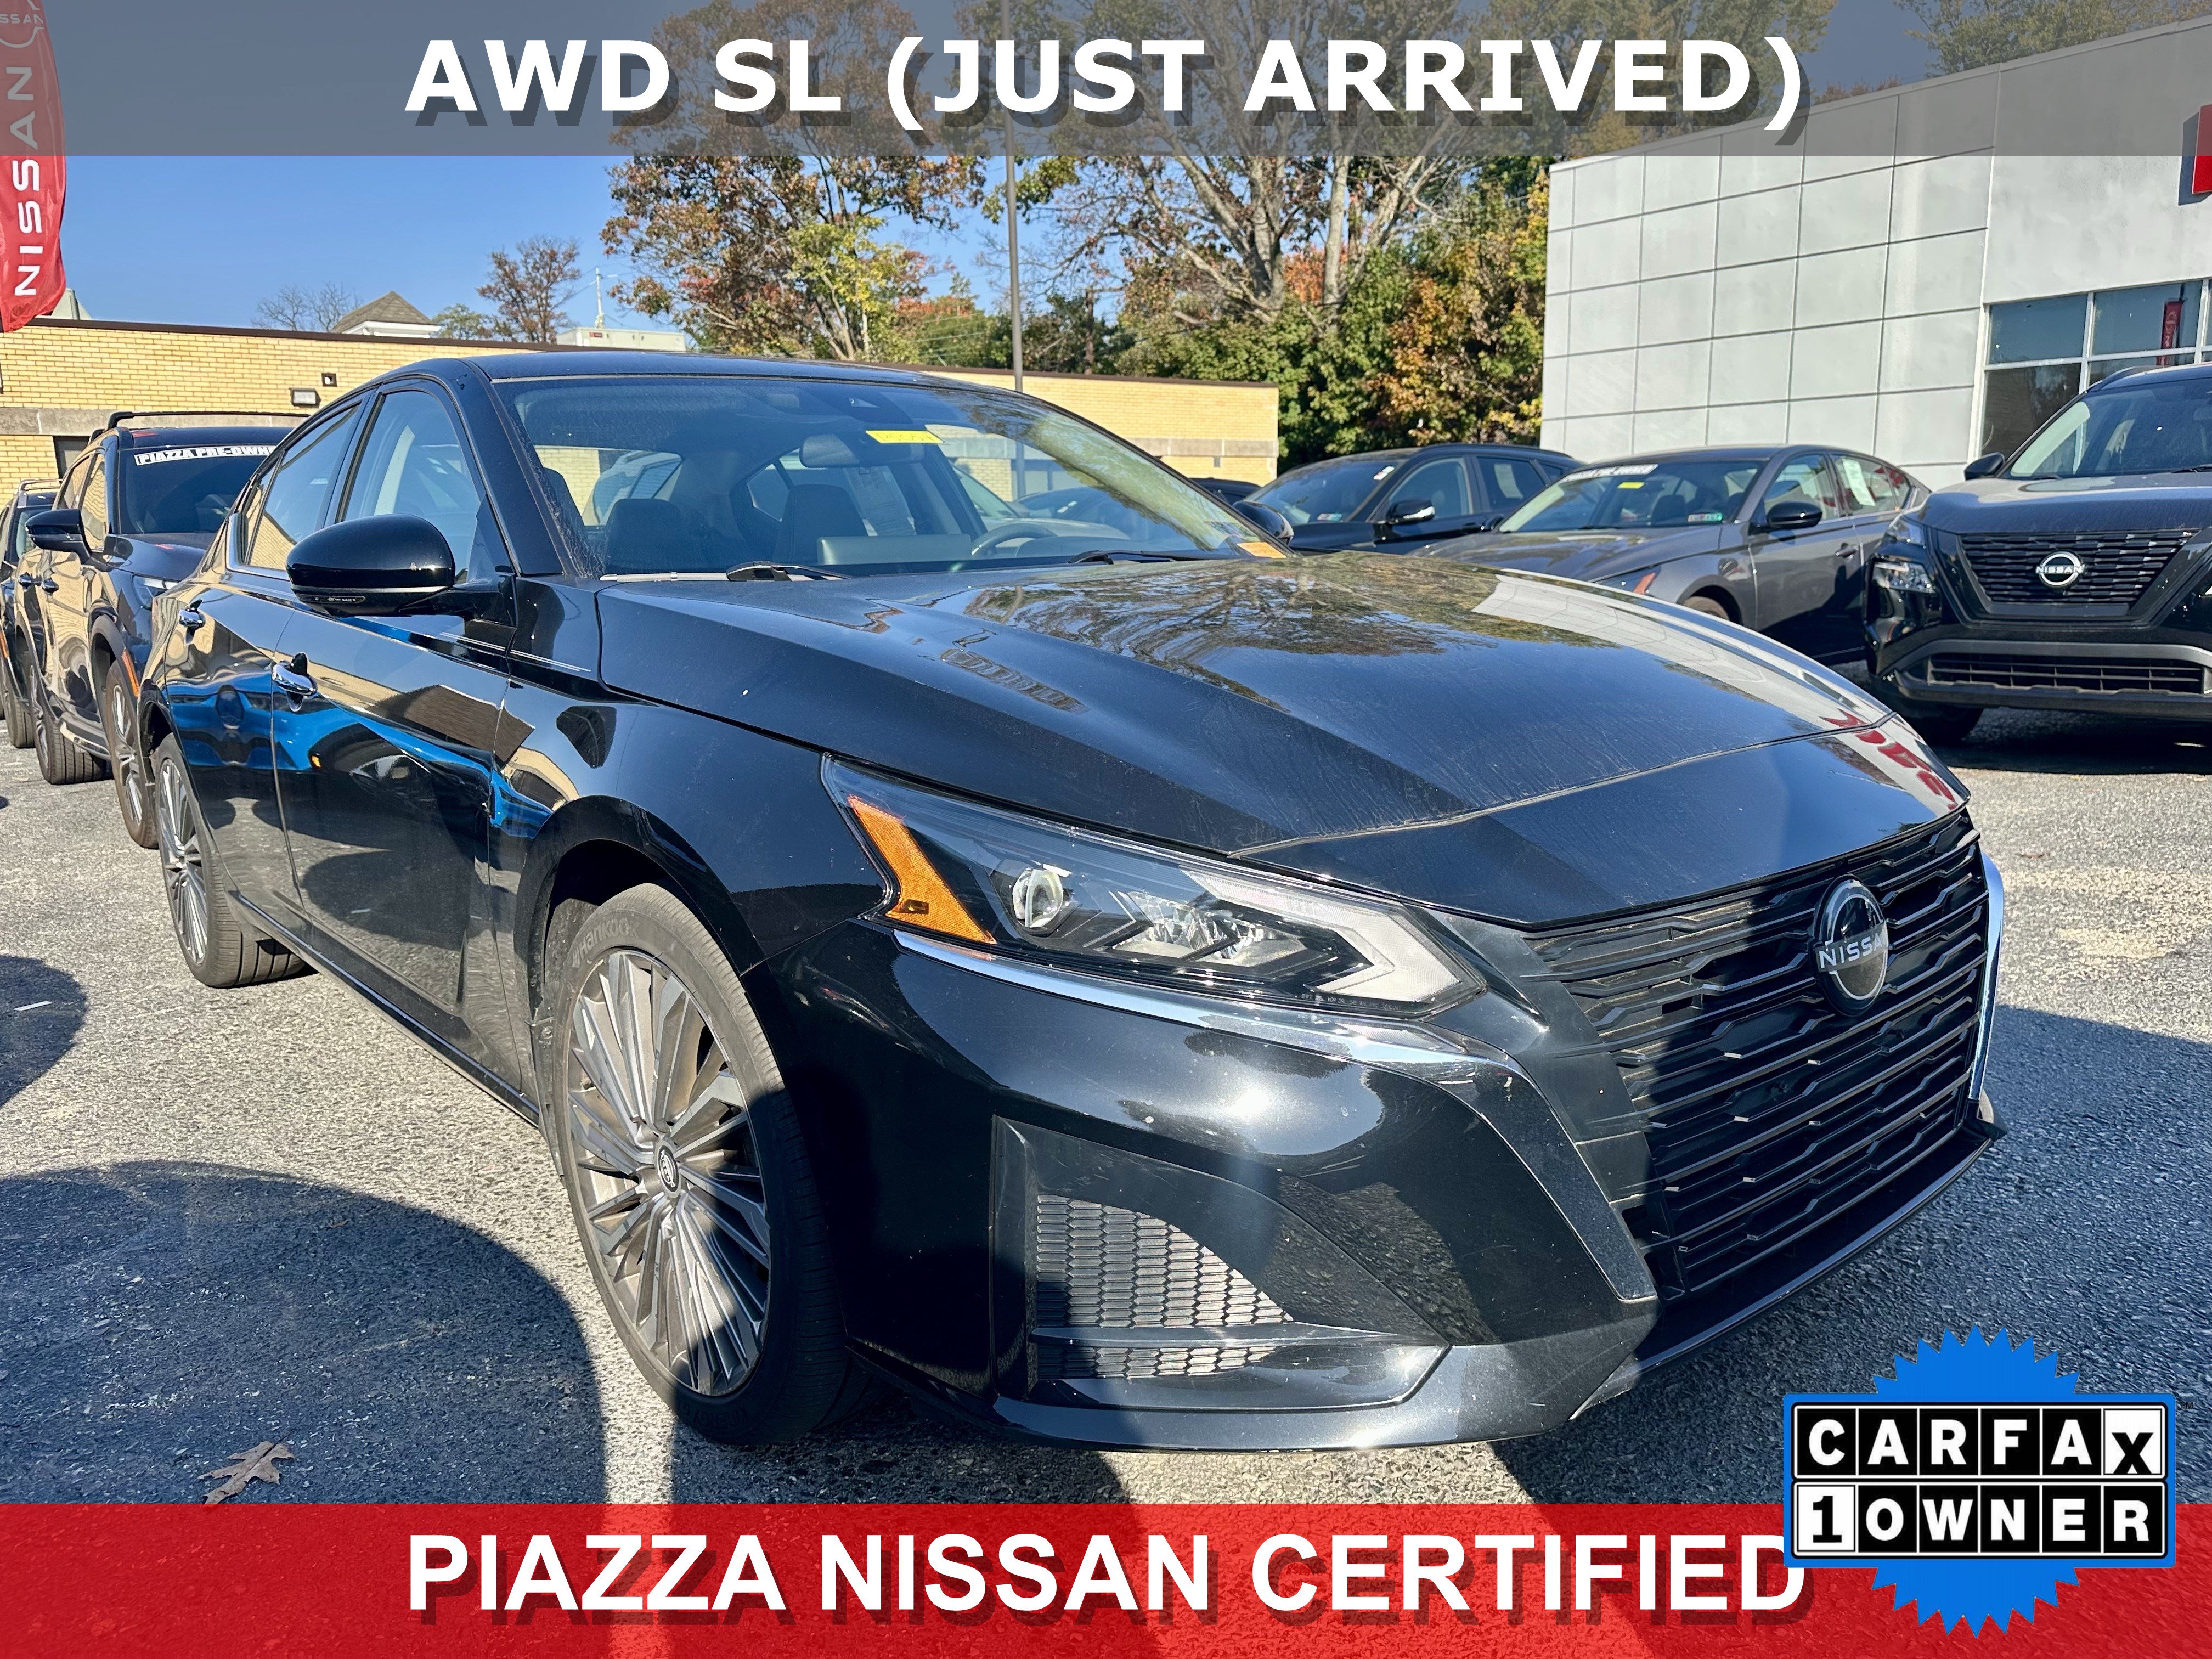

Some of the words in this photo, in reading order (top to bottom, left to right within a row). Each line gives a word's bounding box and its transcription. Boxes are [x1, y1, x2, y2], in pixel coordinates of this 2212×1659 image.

[5, 66, 43, 297] NISSAN
[139, 450, 195, 464] PIAZZA
[2036, 565, 2083, 574] NISSAN
[1819, 932, 1883, 968] NISSA
